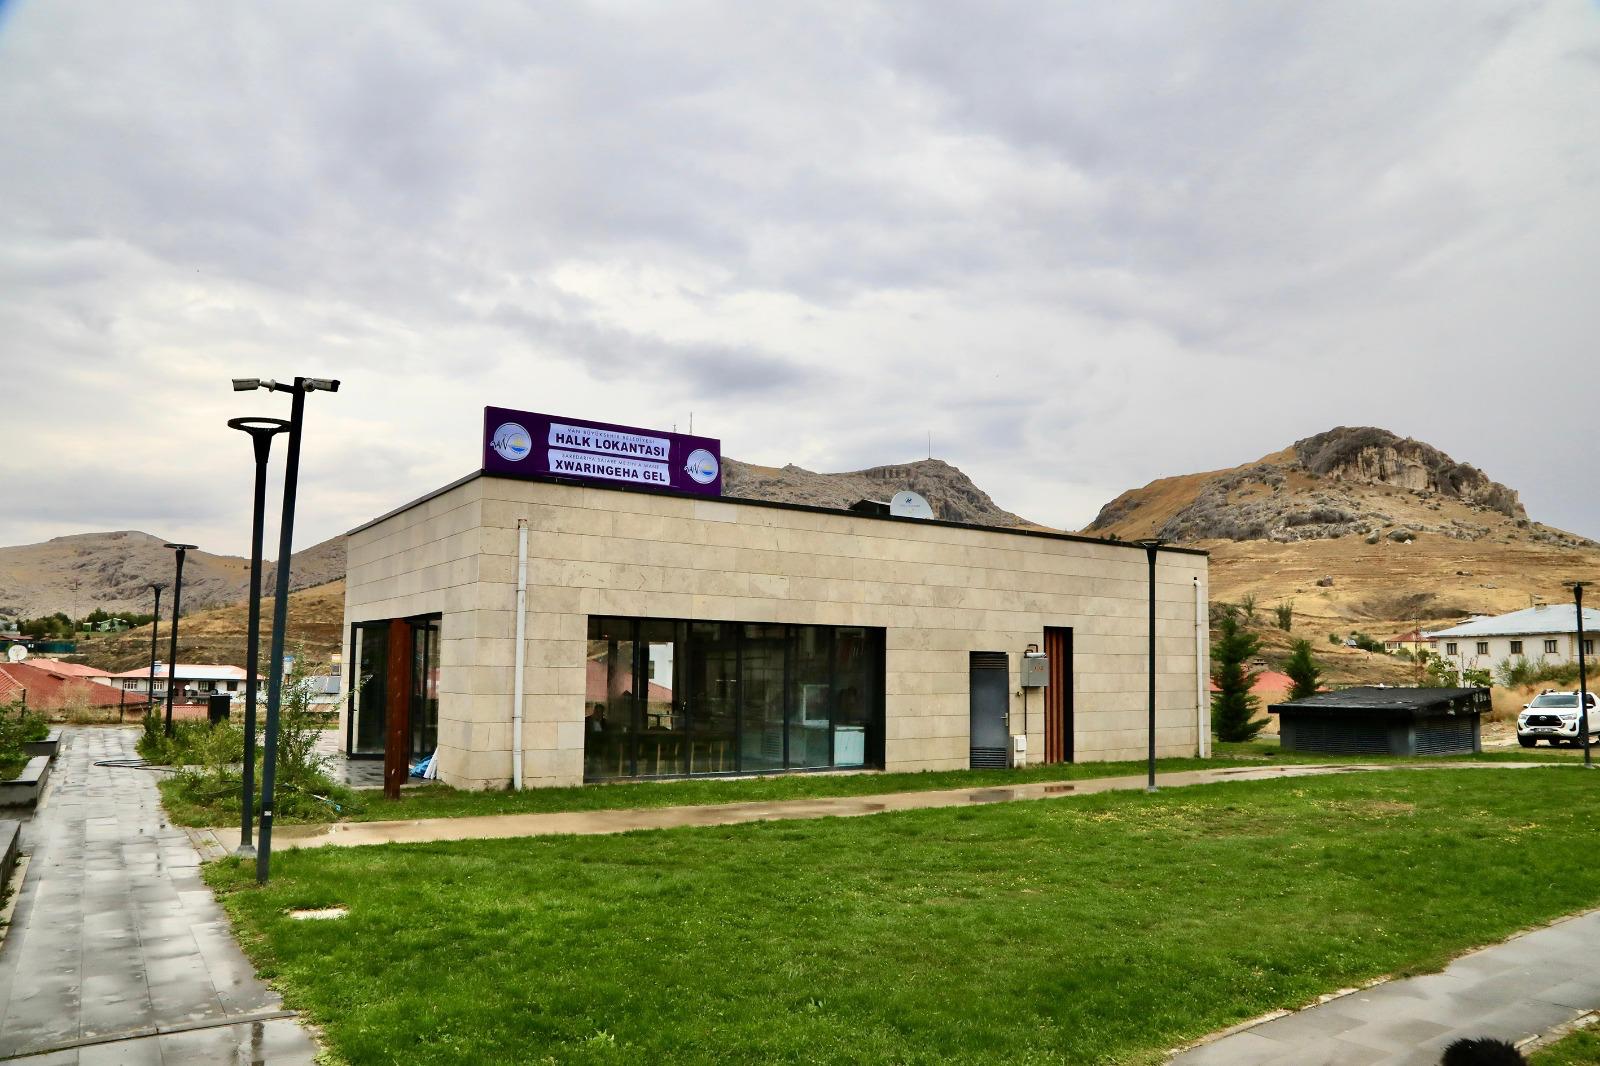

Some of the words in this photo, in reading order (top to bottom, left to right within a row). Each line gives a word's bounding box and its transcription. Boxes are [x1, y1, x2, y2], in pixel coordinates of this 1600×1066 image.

[556, 432, 591, 447] HALK
[595, 438, 665, 457] LOKANTASI
[556, 459, 639, 478] XWARINGEHA
[643, 471, 665, 482] GEL
